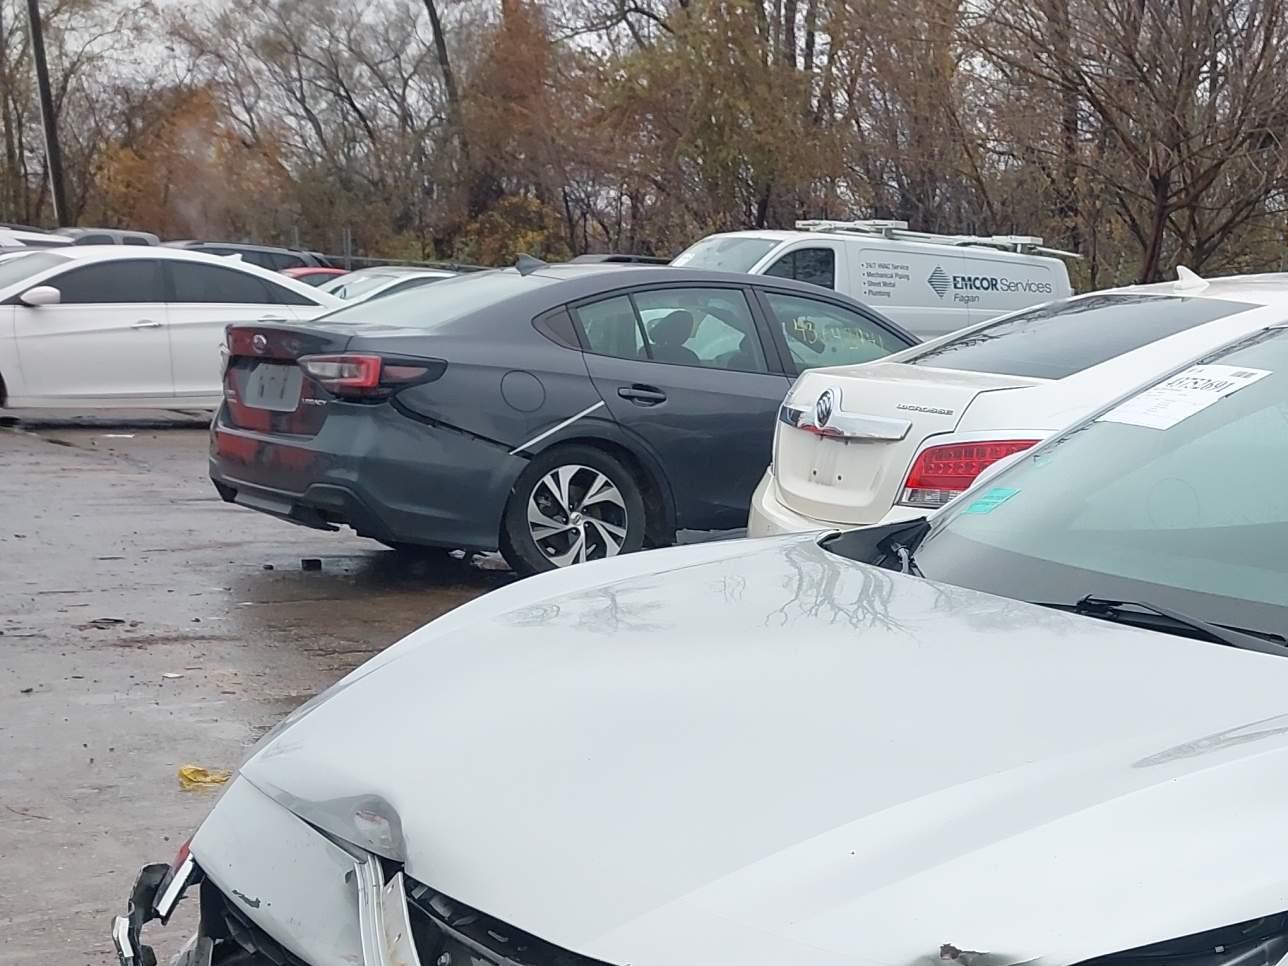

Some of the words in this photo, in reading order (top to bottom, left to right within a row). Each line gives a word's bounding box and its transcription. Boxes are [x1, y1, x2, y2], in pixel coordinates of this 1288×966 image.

[952, 275, 999, 292] EMCOR
[1000, 278, 1053, 294] Services
[953, 293, 980, 304] Fagan
